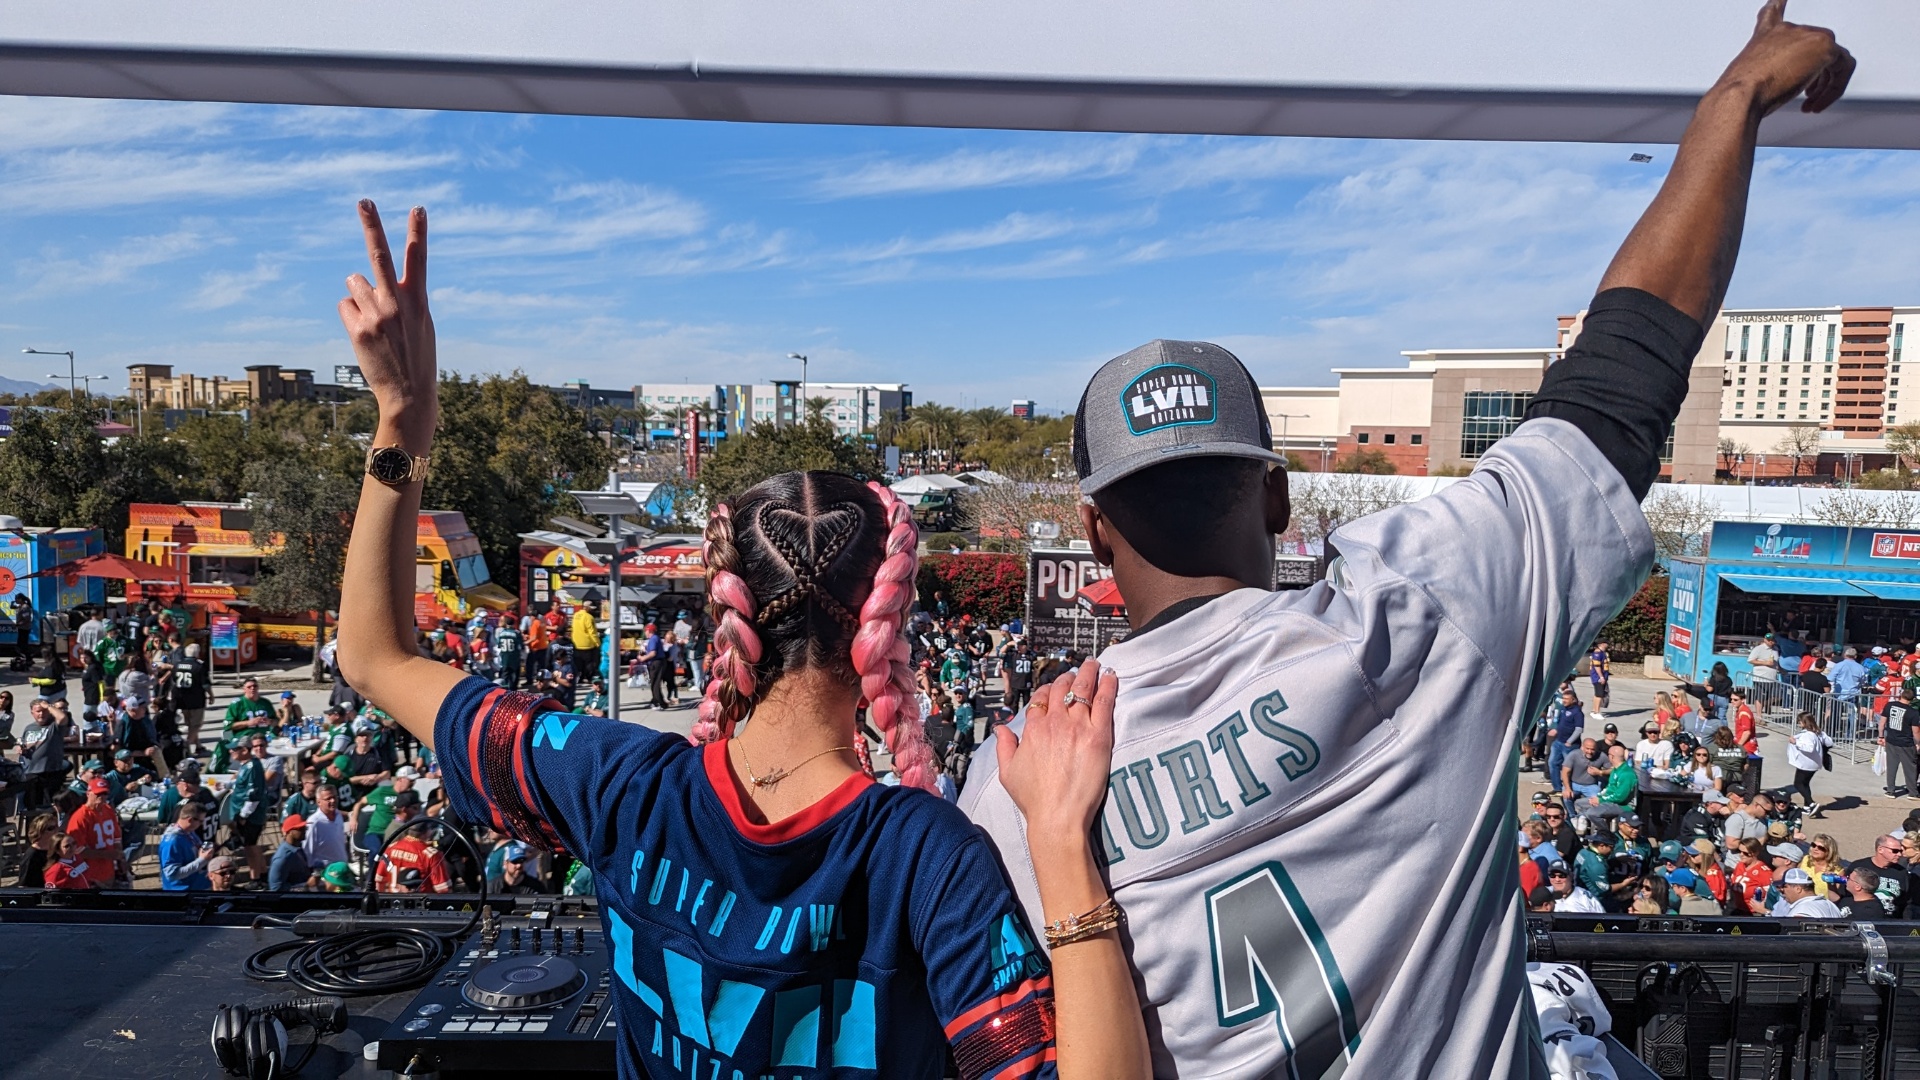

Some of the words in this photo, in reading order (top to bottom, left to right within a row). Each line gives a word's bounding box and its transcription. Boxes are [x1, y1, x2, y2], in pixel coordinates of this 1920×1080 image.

[1729, 315, 1794, 323] RENAISSANCE
[1797, 314, 1828, 322] HOTEL
[1136, 376, 1166, 394] SUPER
[1171, 374, 1198, 386] BOWL
[1131, 385, 1209, 418] LVII
[1151, 408, 1195, 425] ARIZONA
[1277, 575, 1310, 583] SIDES
[1672, 588, 1694, 613] LVII
[1033, 626, 1056, 634] TOP
[1057, 627, 1072, 635] 10
[1015, 660, 1031, 673] 20
[93, 819, 115, 849] 19
[630, 850, 737, 938] SUPER
[607, 905, 877, 1070] LVII
